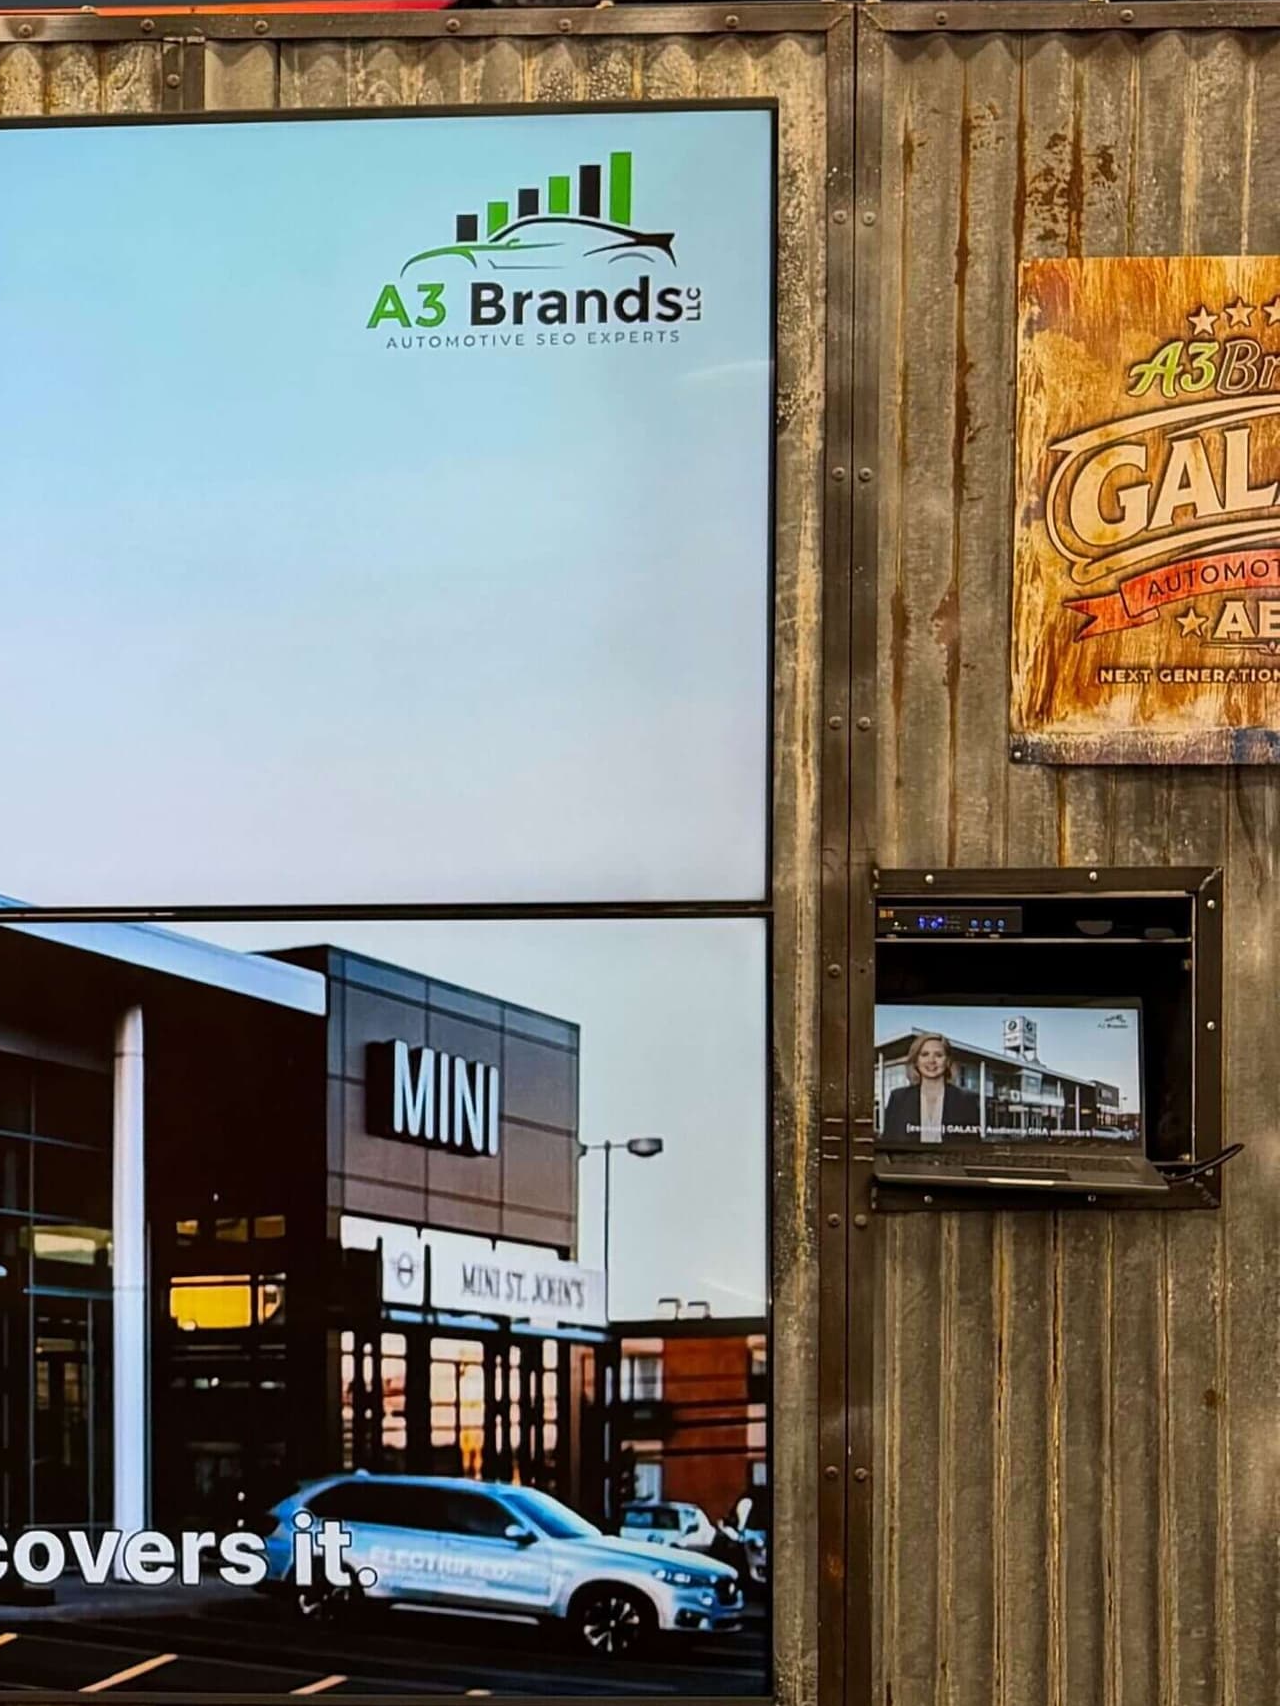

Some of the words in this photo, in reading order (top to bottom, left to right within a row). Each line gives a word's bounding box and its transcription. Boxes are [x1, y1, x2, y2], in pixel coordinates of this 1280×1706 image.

[366, 282, 447, 329] A3
[470, 275, 684, 326] Brands
[686, 286, 702, 322] LLC
[386, 332, 525, 349] AUTOMOTIVE
[535, 331, 577, 346] SEO
[587, 329, 681, 345] EXPERTS
[1070, 428, 1280, 546] GAL
[1100, 670, 1151, 682] NEXT
[393, 1039, 500, 1156] MINI
[461, 1263, 502, 1299] MINI
[507, 1272, 529, 1303] ST.
[532, 1273, 585, 1310] JOHN'S
[292, 1511, 380, 1588] it.
